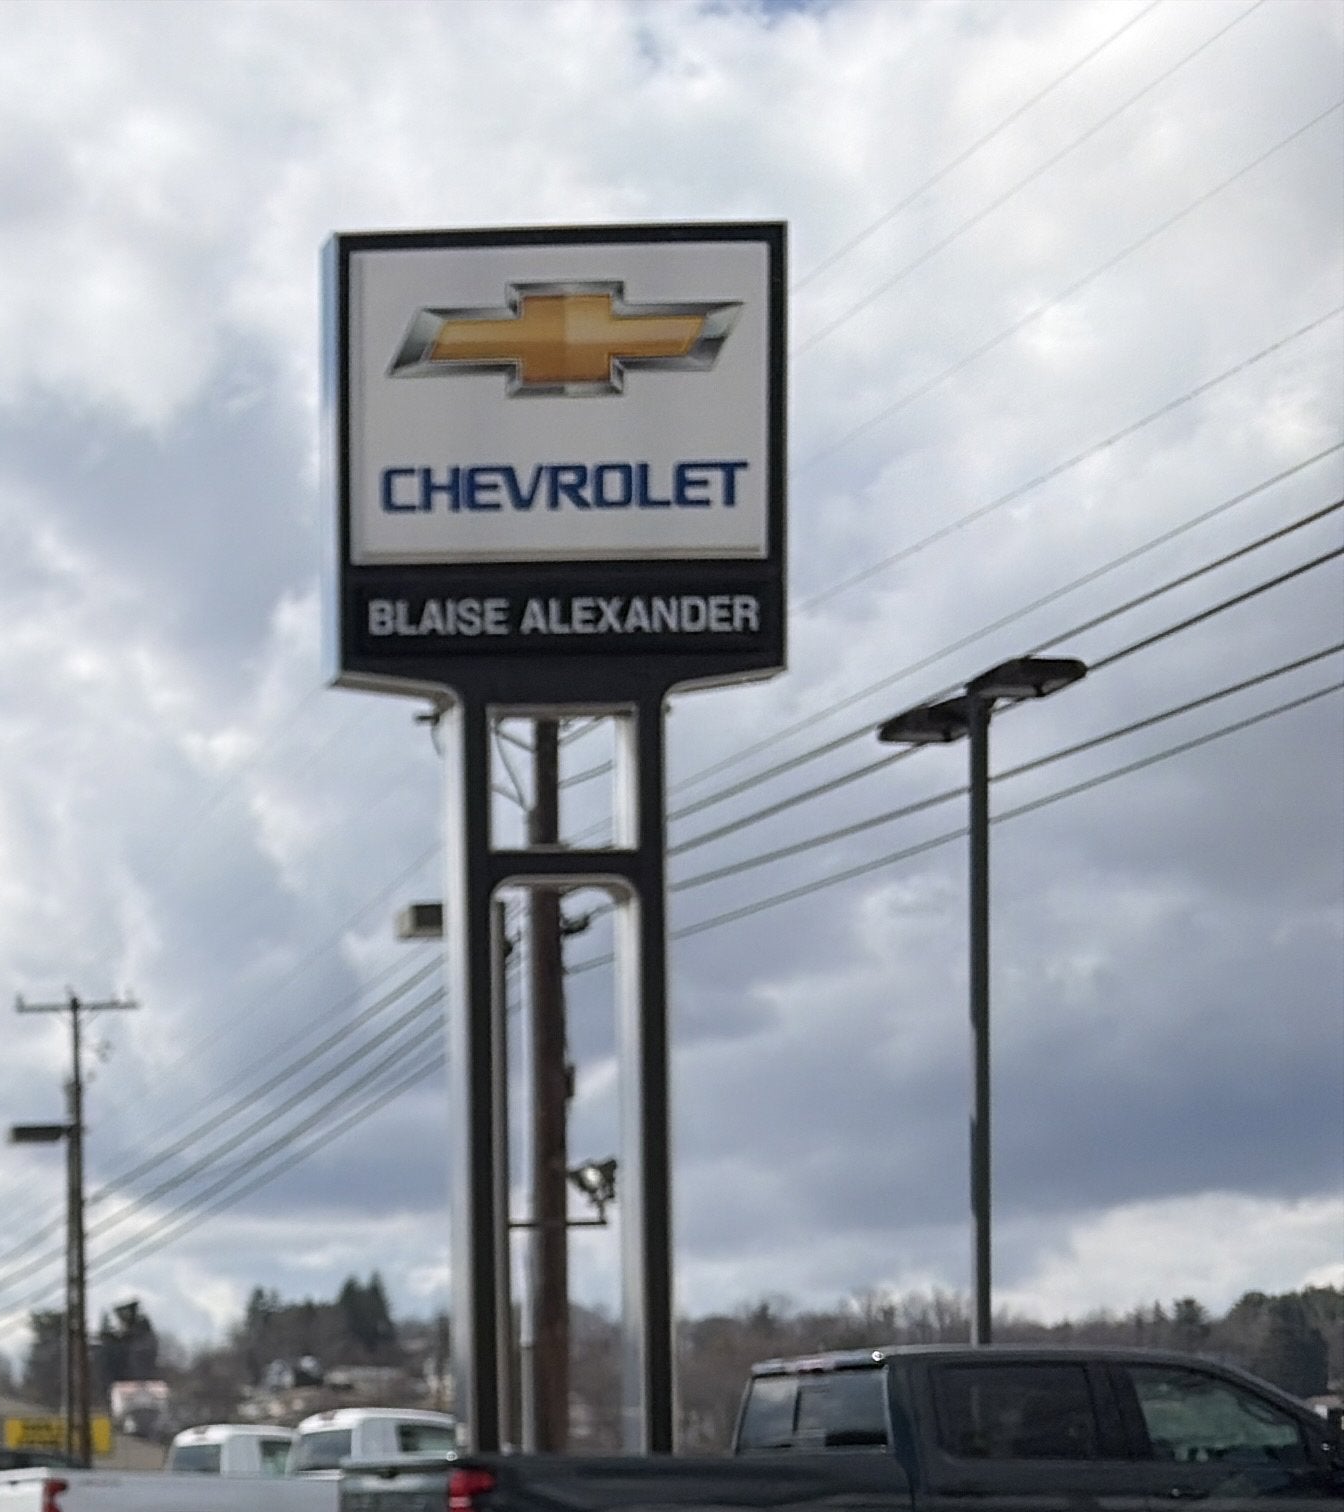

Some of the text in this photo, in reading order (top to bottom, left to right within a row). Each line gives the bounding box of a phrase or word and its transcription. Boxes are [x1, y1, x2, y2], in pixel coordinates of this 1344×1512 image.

[382, 462, 748, 512] CHEVROLET
[368, 596, 761, 636] BLAISE ALEXANDER
